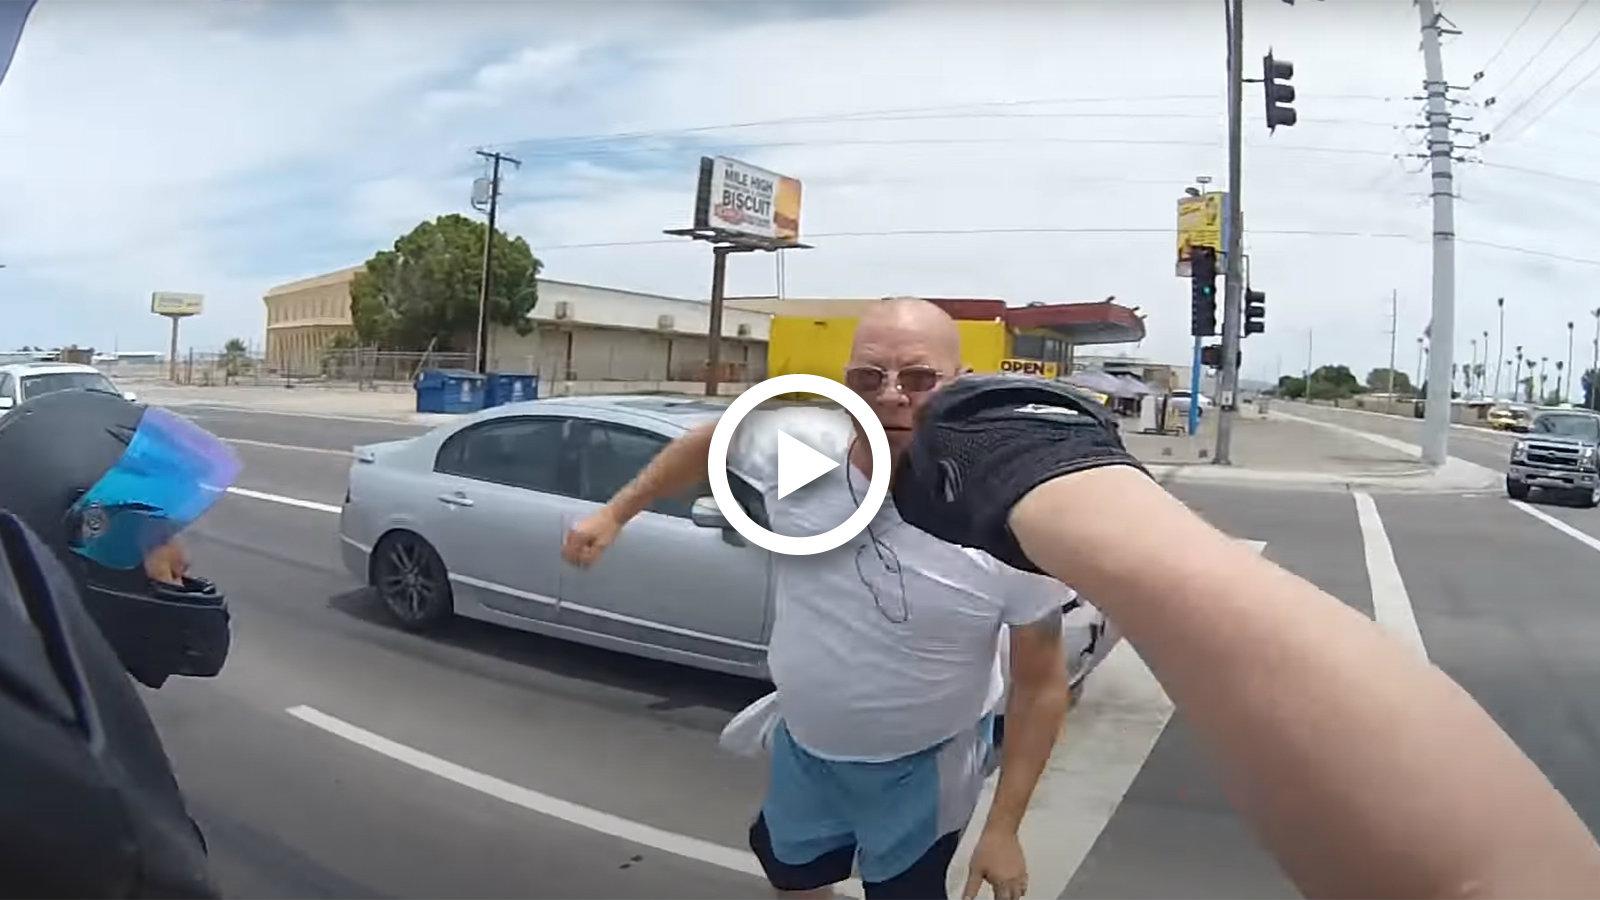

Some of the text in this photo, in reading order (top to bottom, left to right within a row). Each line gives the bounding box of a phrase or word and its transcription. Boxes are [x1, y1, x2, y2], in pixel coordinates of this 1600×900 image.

[724, 169, 748, 186] MILE
[750, 176, 774, 192] HIGH
[722, 189, 771, 216] BISCUIT
[1000, 360, 1045, 375] OPEN
